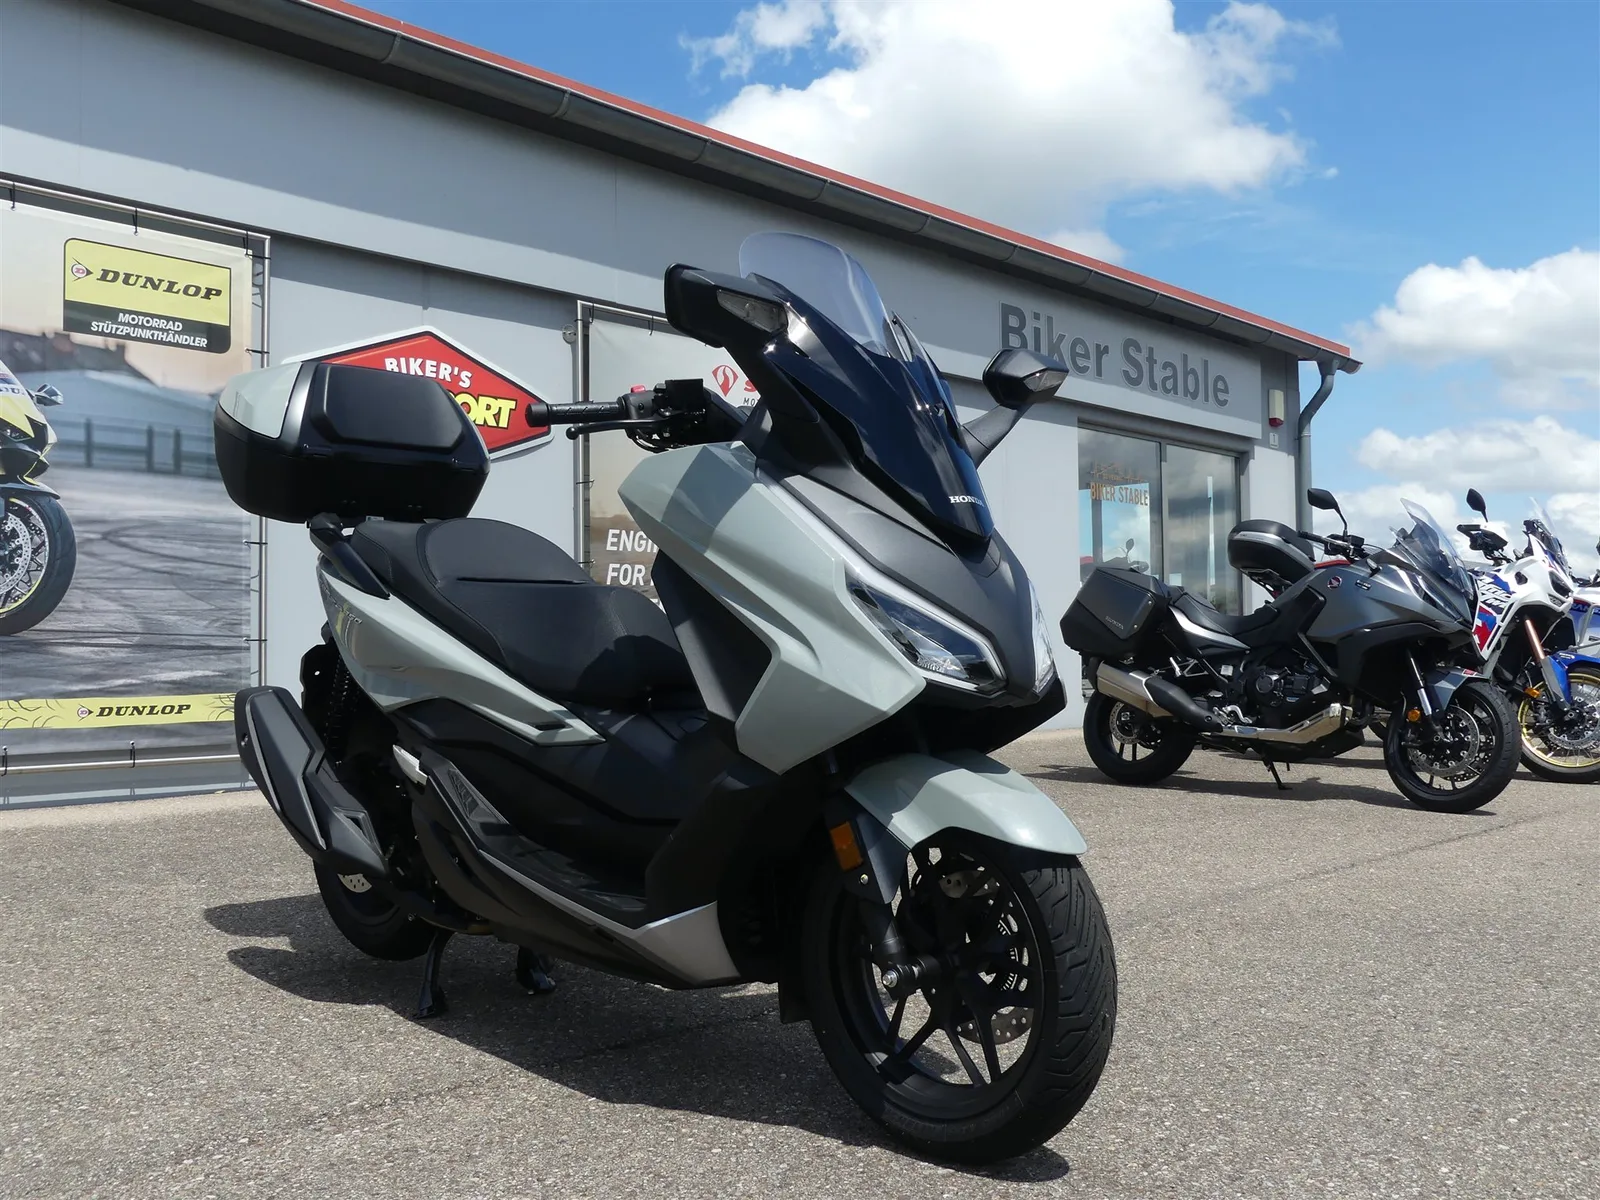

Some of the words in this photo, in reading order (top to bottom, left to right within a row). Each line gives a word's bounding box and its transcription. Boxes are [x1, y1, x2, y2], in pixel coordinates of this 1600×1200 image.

[96, 268, 222, 300] DUNLOP
[90, 320, 208, 348] STÜTZPUNKTHÄNDLER
[118, 312, 183, 331] MOTORRAD
[1001, 302, 1109, 378] Biker
[1120, 337, 1230, 407] Stable
[384, 357, 473, 389] BIKER'S
[448, 390, 517, 429] ORT
[1090, 481, 1116, 502] BIKER
[1118, 486, 1149, 506] STABLE
[606, 528, 660, 553] ENGI
[606, 563, 646, 586] FOR
[96, 704, 191, 717] DUNLOP
